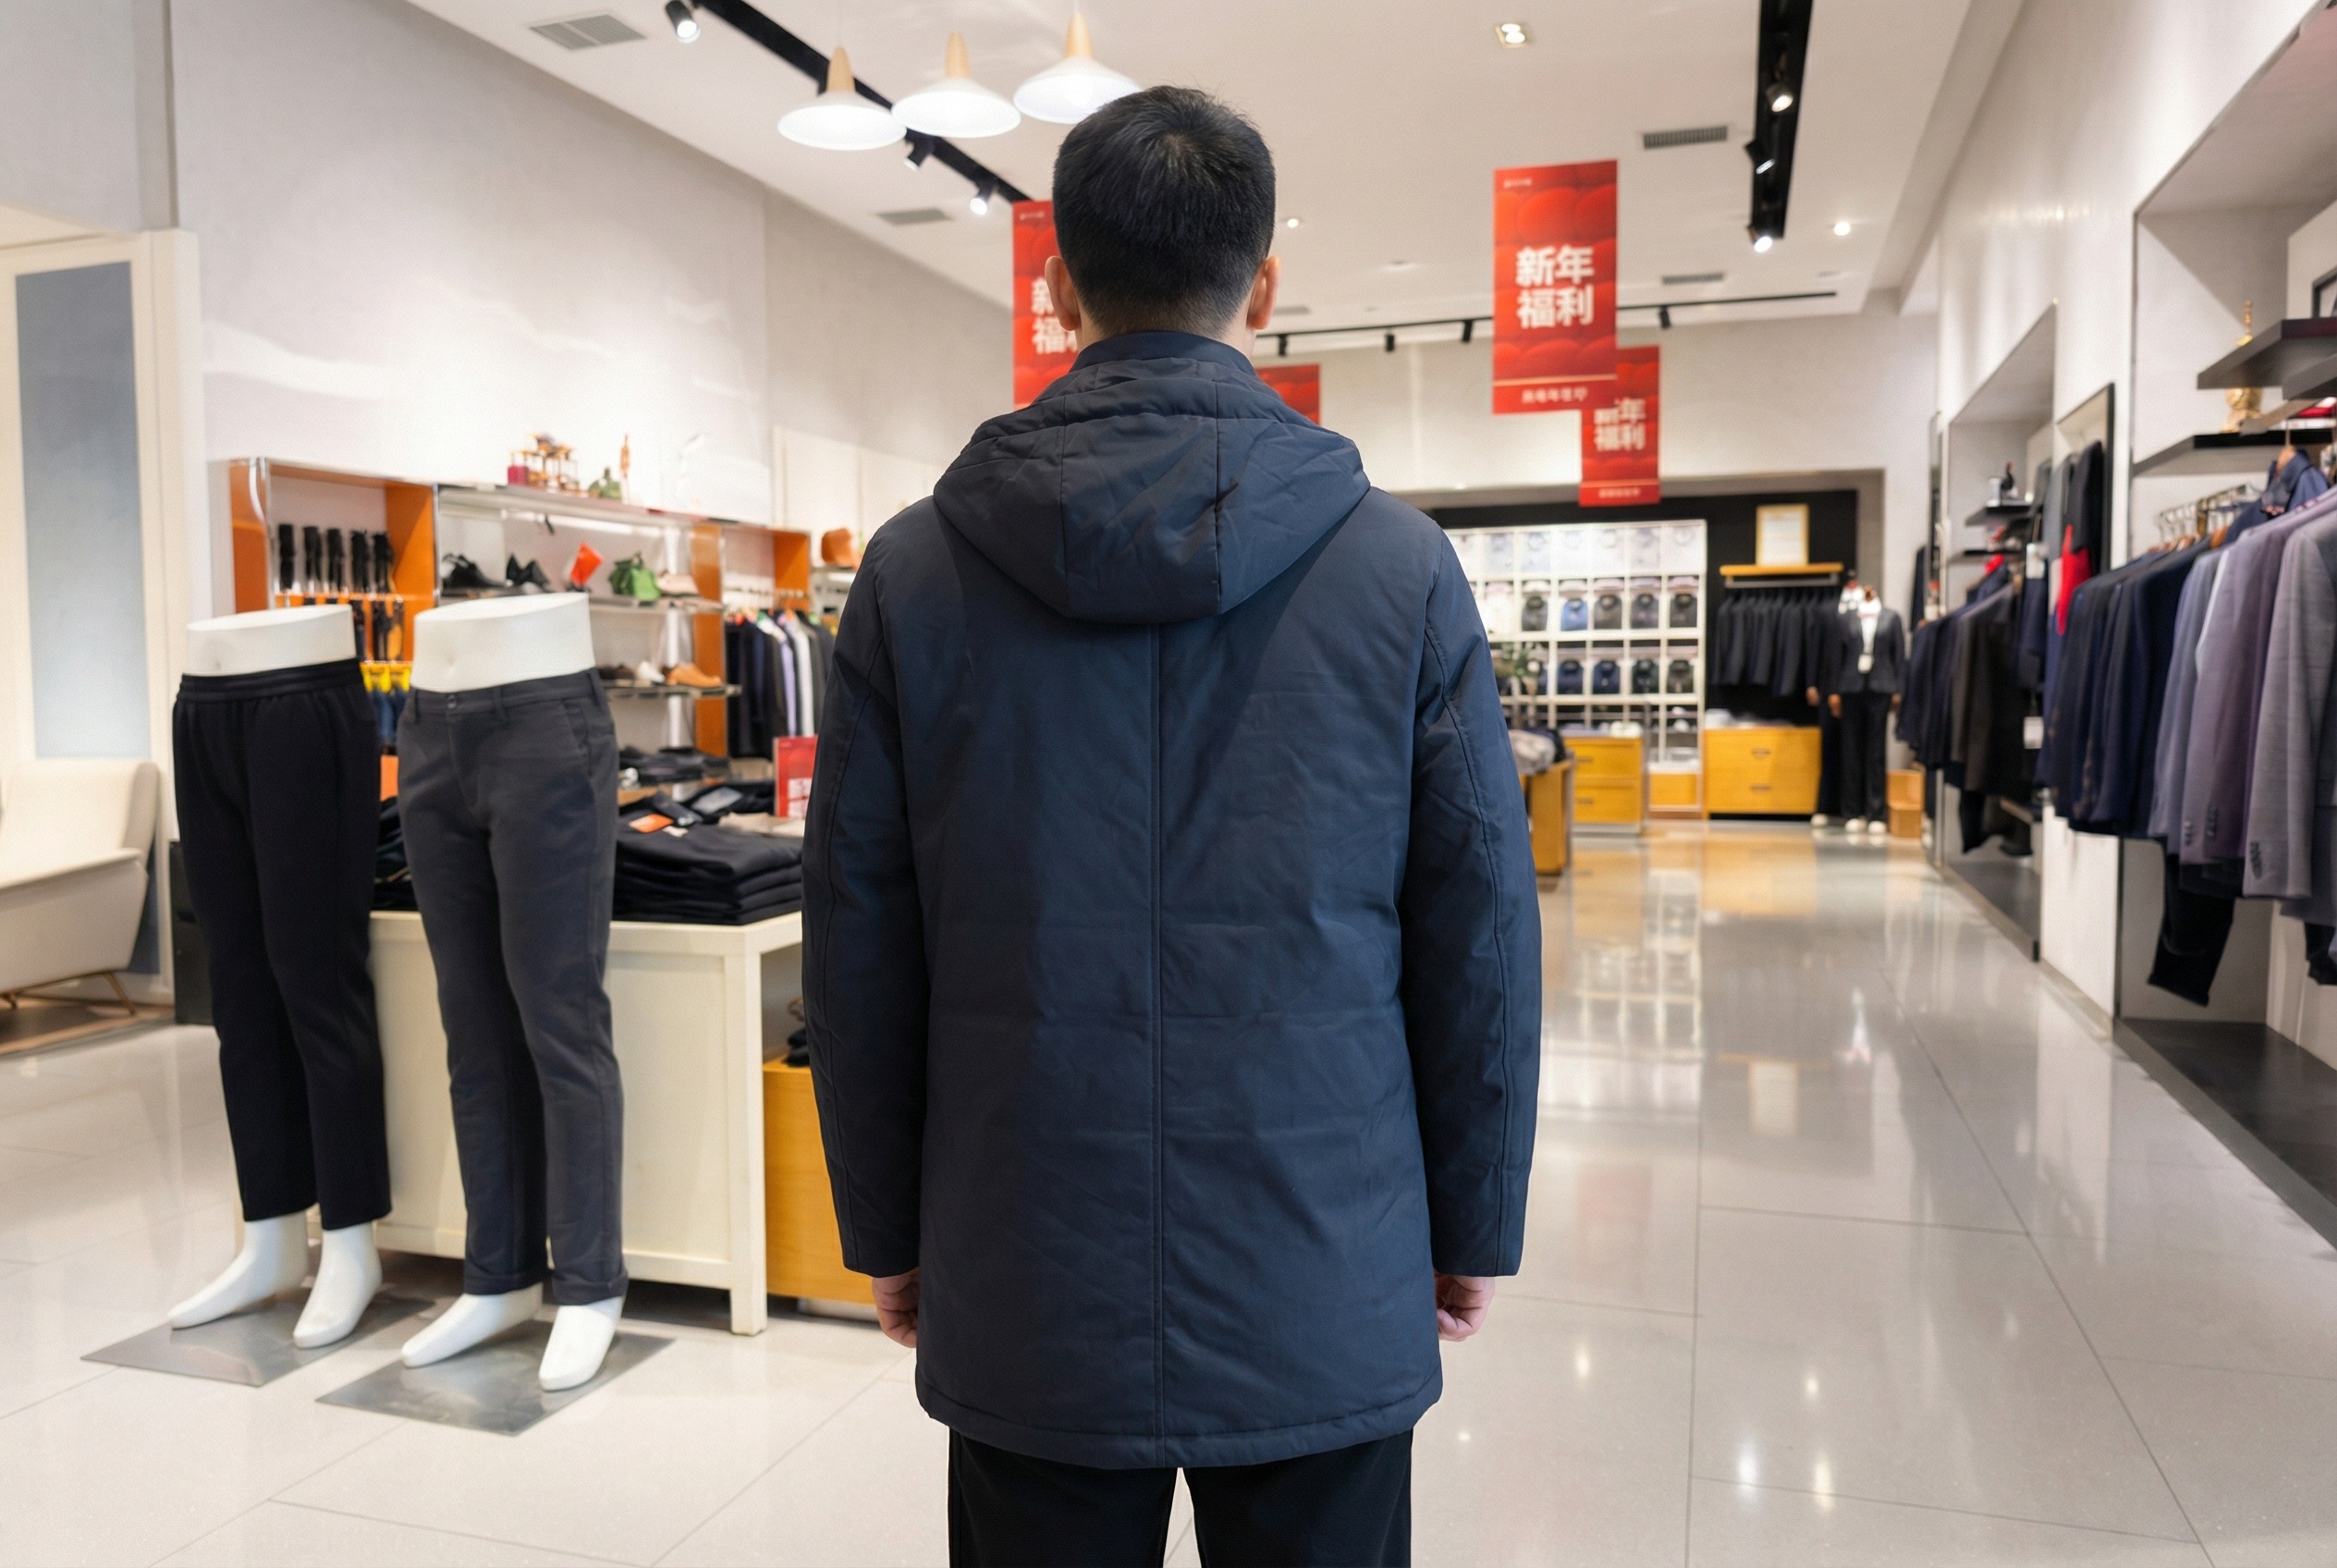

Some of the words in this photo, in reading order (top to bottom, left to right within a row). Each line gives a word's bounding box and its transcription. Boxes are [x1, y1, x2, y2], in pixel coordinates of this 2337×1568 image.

[1516, 243, 1594, 288] 新年
[1031, 276, 1055, 315] 新
[1516, 283, 1594, 329] 福利
